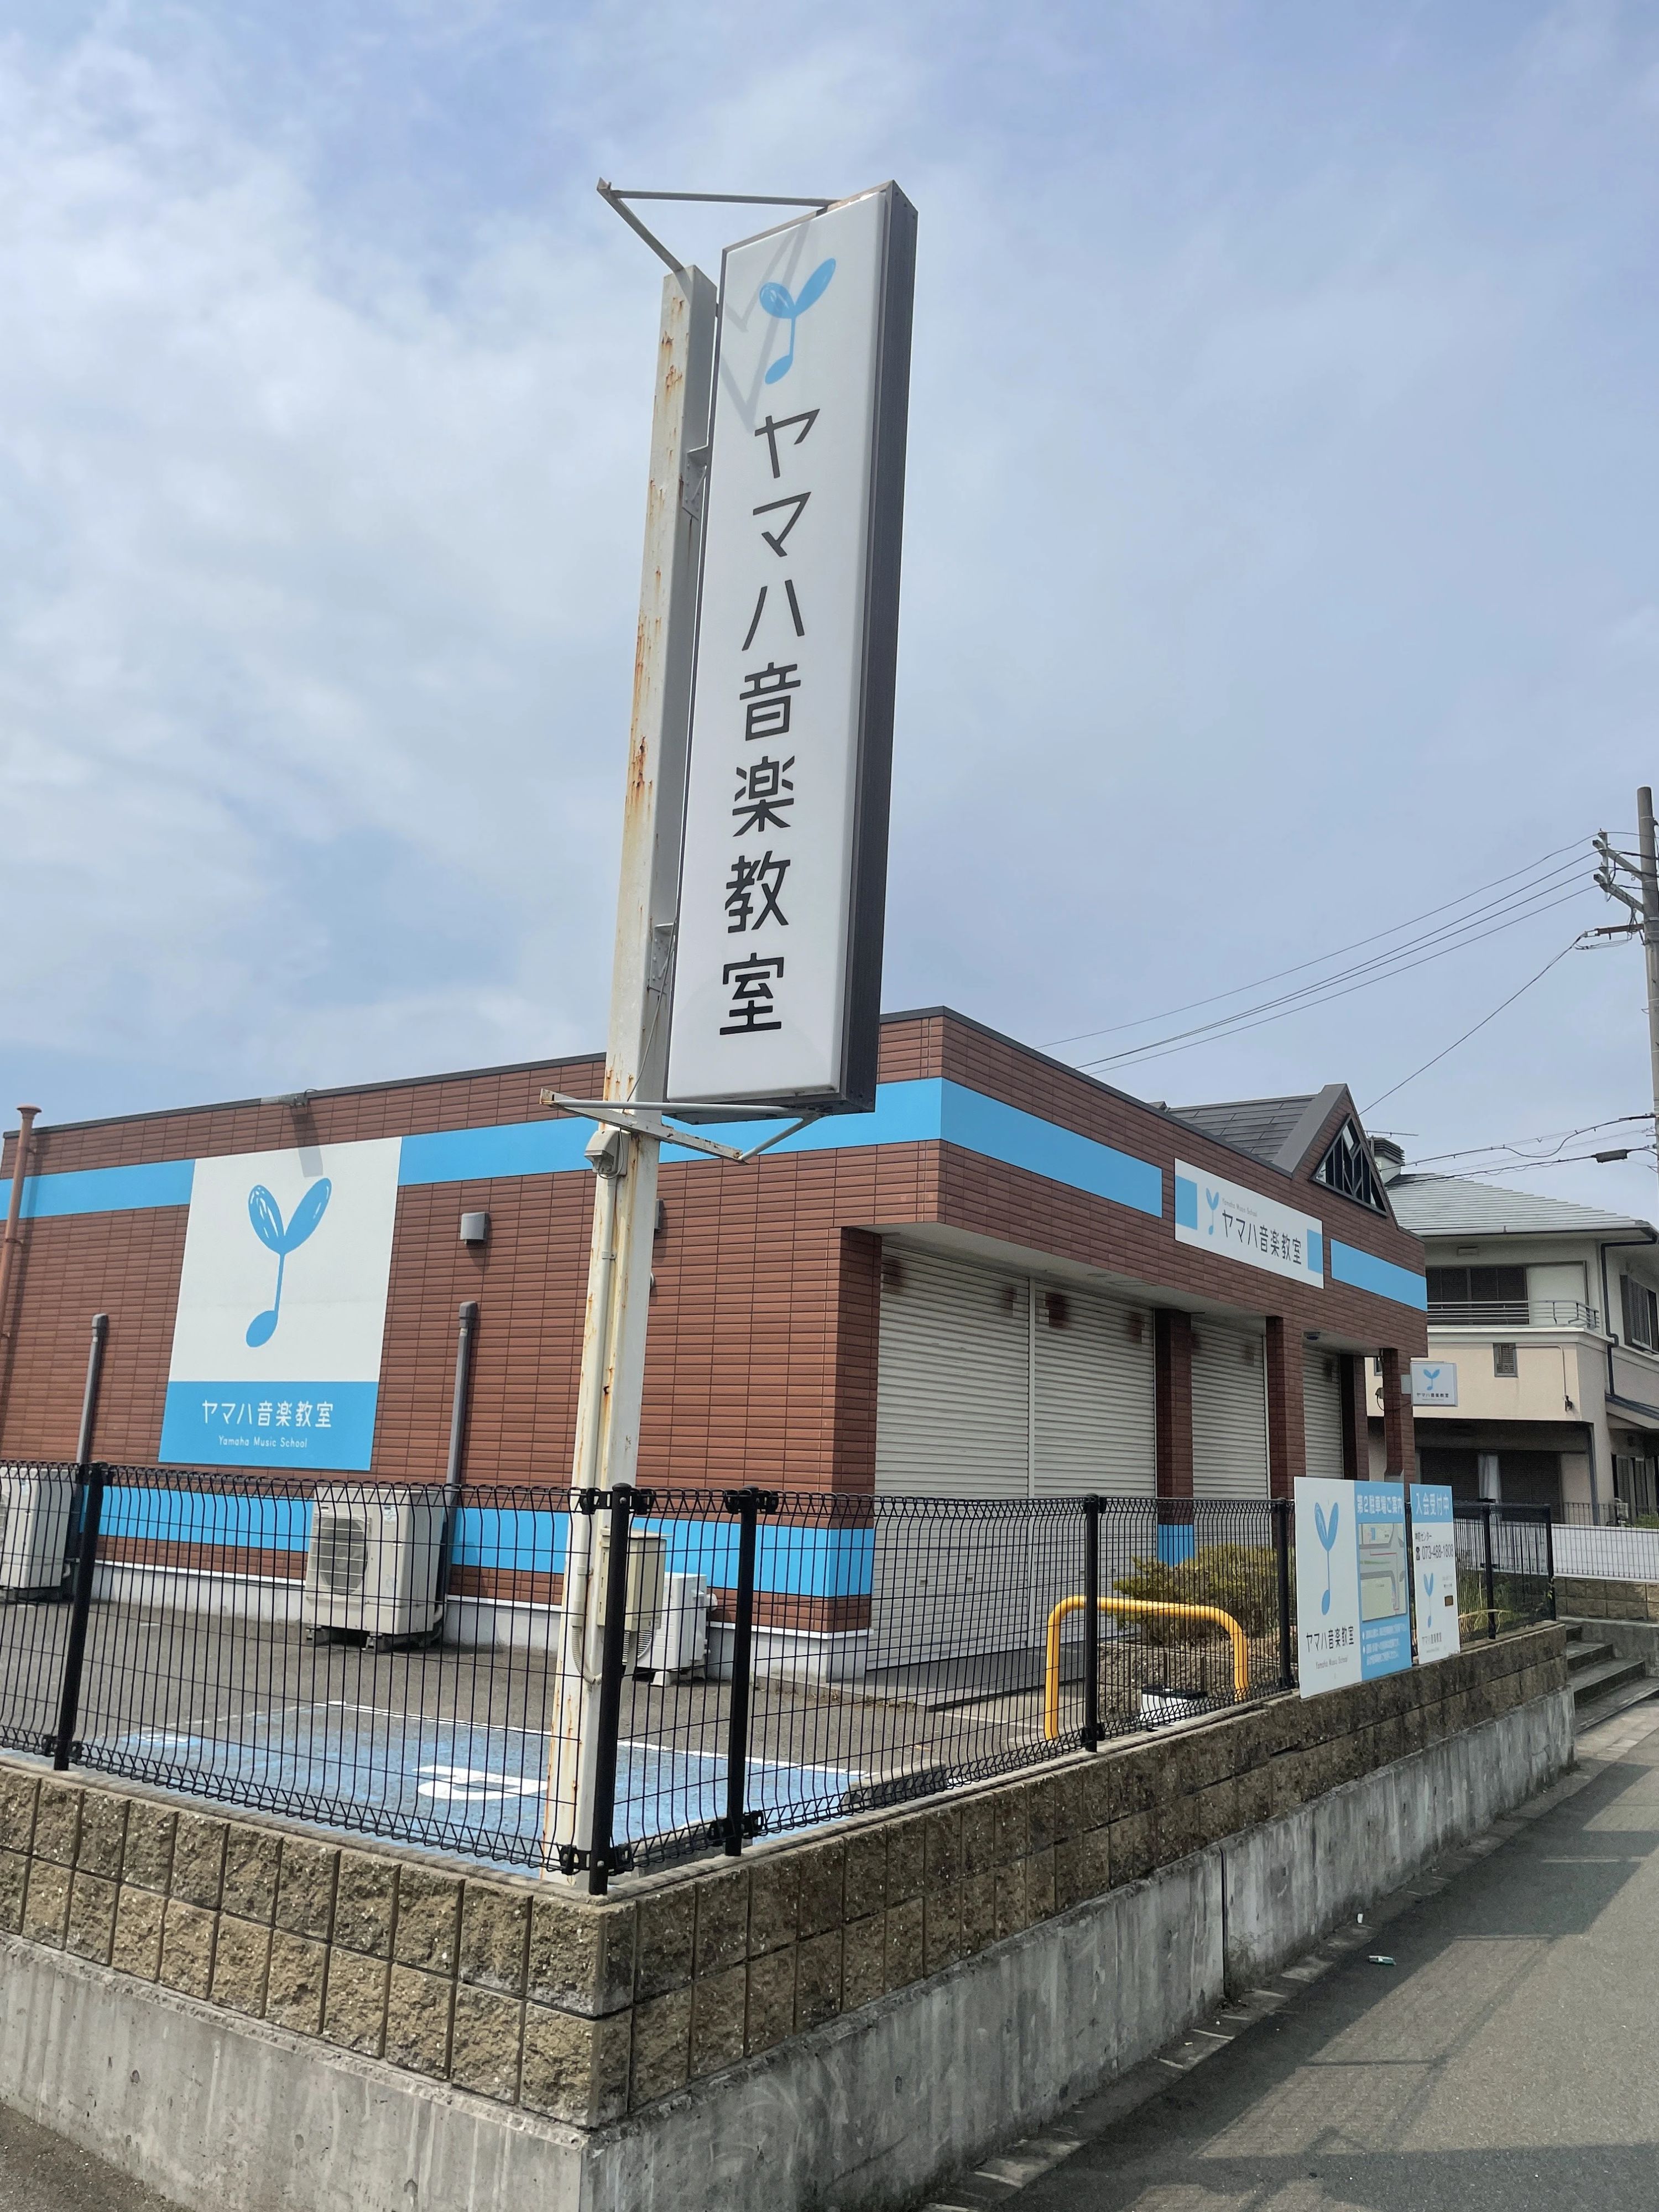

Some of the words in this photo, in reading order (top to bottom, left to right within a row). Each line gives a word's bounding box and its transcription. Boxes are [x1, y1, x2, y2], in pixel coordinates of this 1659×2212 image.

[718, 407, 820, 1035] ヤマハ音楽教室
[1222, 1209, 1302, 1265] ヤマハ音楽教室
[201, 1399, 334, 1428] ヤマハ音楽教室
[218, 1435, 249, 1447] Yamaha
[253, 1436, 276, 1447] Music
[280, 1437, 308, 1448] School
[1416, 1493, 1449, 1516] 入会受付中
[1306, 1625, 1354, 1652] ヤマハ音楽教室
